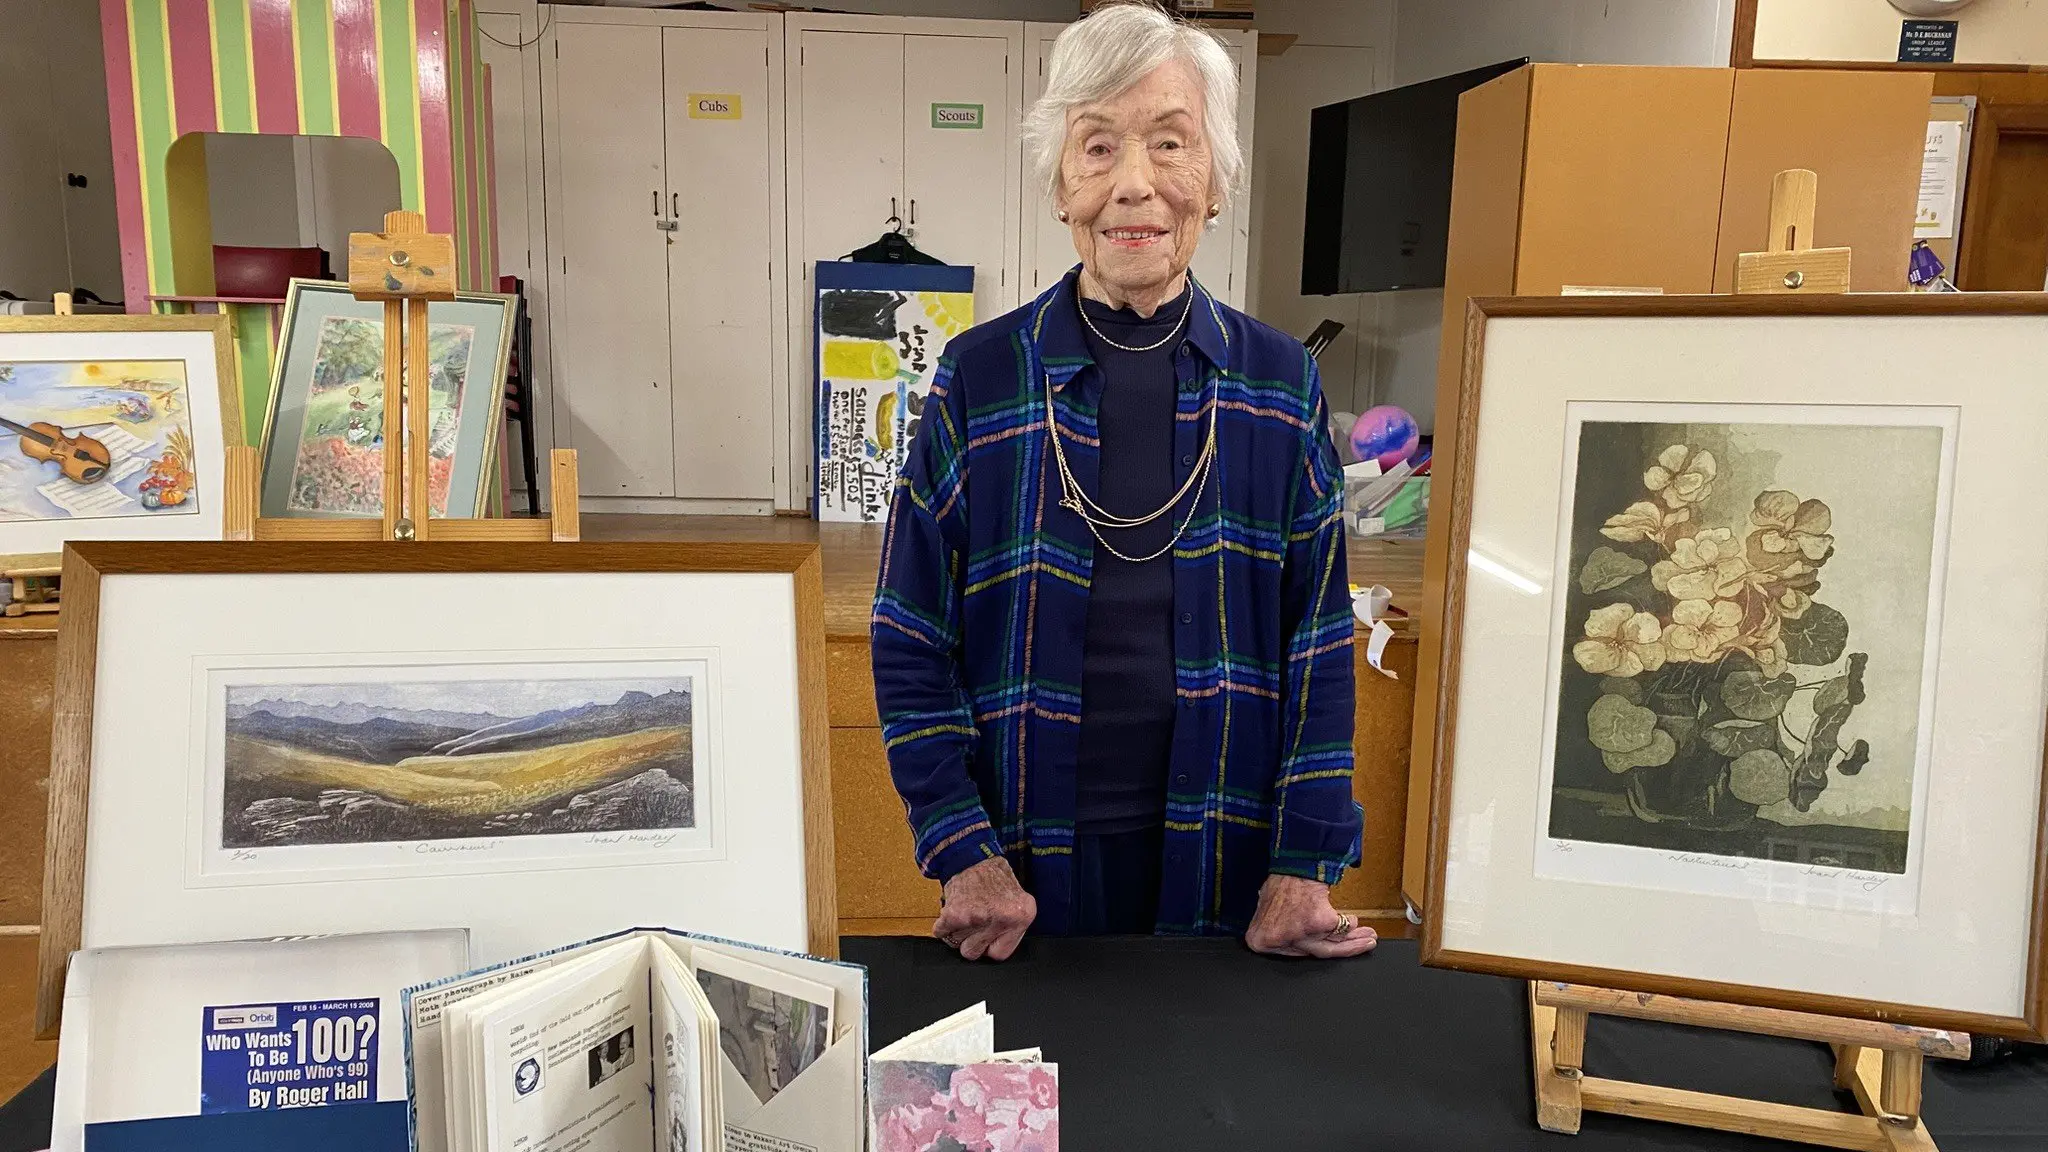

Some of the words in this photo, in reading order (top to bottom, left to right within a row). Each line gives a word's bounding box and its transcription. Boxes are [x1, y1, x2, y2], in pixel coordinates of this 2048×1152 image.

[699, 100, 728, 112] Cubs
[938, 109, 976, 122] Scouts
[861, 461, 886, 521] drinks
[418, 993, 442, 1006] Cover
[444, 979, 494, 999] photograph
[498, 975, 507, 984] by
[419, 1004, 440, 1014] Moth
[206, 1034, 241, 1051] Who
[245, 1032, 292, 1049] Wants
[292, 1014, 376, 1065] 100?
[248, 1050, 265, 1067] To
[269, 1050, 289, 1067] Be
[247, 1069, 301, 1086] (Anyone
[305, 1065, 344, 1081] Who's
[347, 1062, 368, 1078] 99)
[248, 1088, 271, 1109] By
[276, 1085, 330, 1107] Roger
[334, 1080, 368, 1100] Hall
